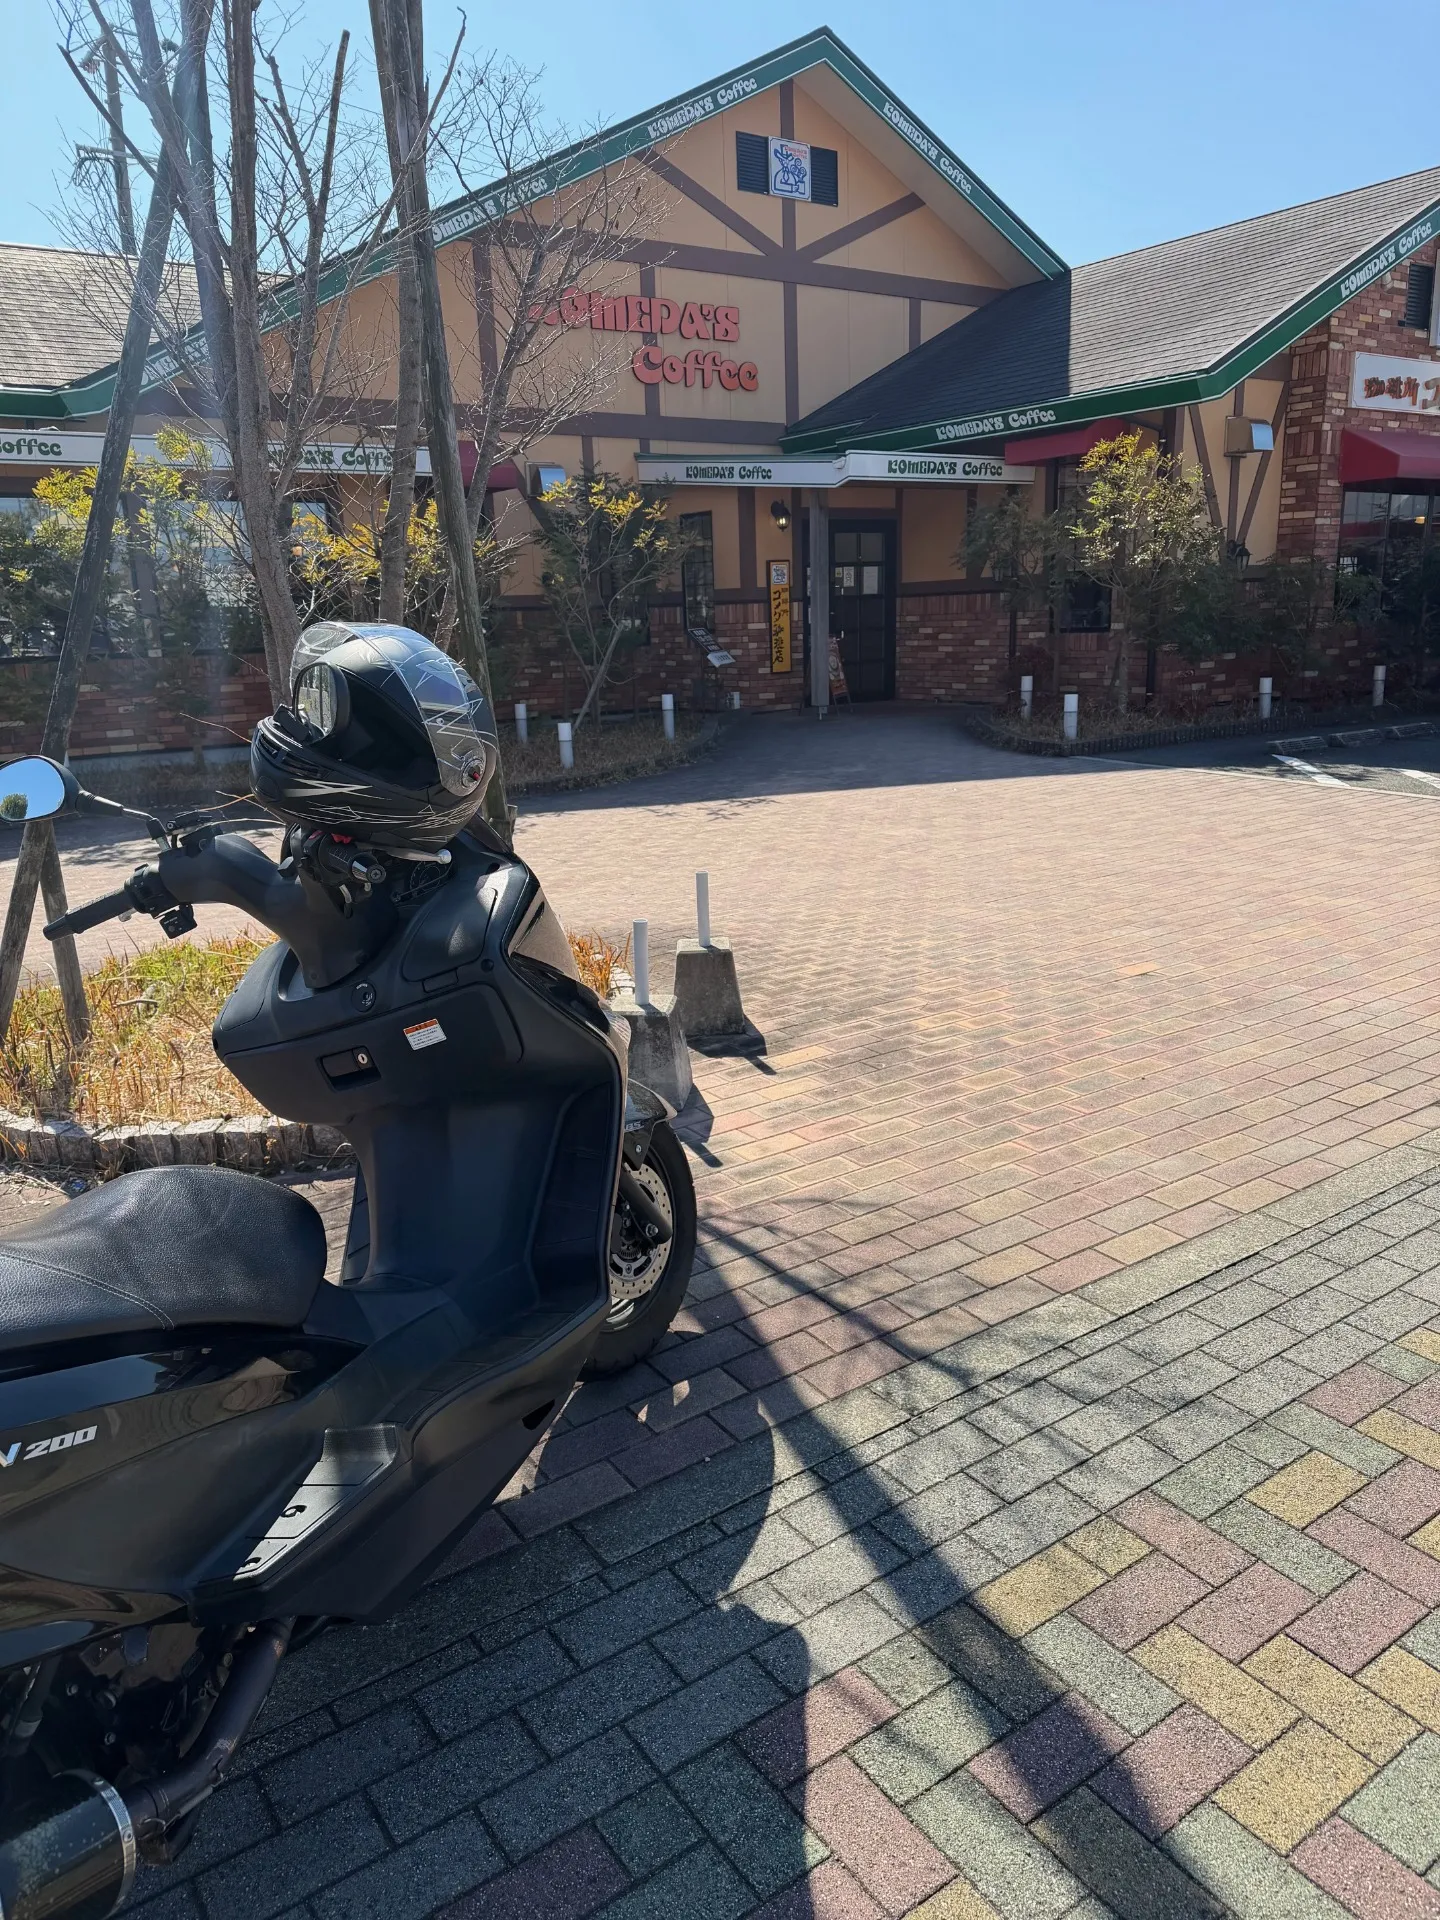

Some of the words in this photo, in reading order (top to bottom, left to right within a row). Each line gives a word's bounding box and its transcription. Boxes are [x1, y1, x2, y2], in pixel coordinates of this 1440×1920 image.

[716, 77, 758, 105] Coffee
[882, 101, 939, 160] KOMEDA'S
[939, 157, 972, 195] Coffee
[1340, 245, 1396, 299] KOMEDA'S
[1398, 221, 1433, 254] Coffee
[631, 344, 760, 392] Coffee
[935, 416, 1005, 441] KOMEDA'S
[1008, 408, 1057, 428] Coffee
[0, 437, 62, 456] offee
[685, 465, 735, 480] KOMEDA'S
[738, 465, 773, 480] Coffee
[887, 459, 957, 475] KOMEDA'S
[962, 461, 1003, 477] Coffee
[23, 1424, 98, 1461] 200
